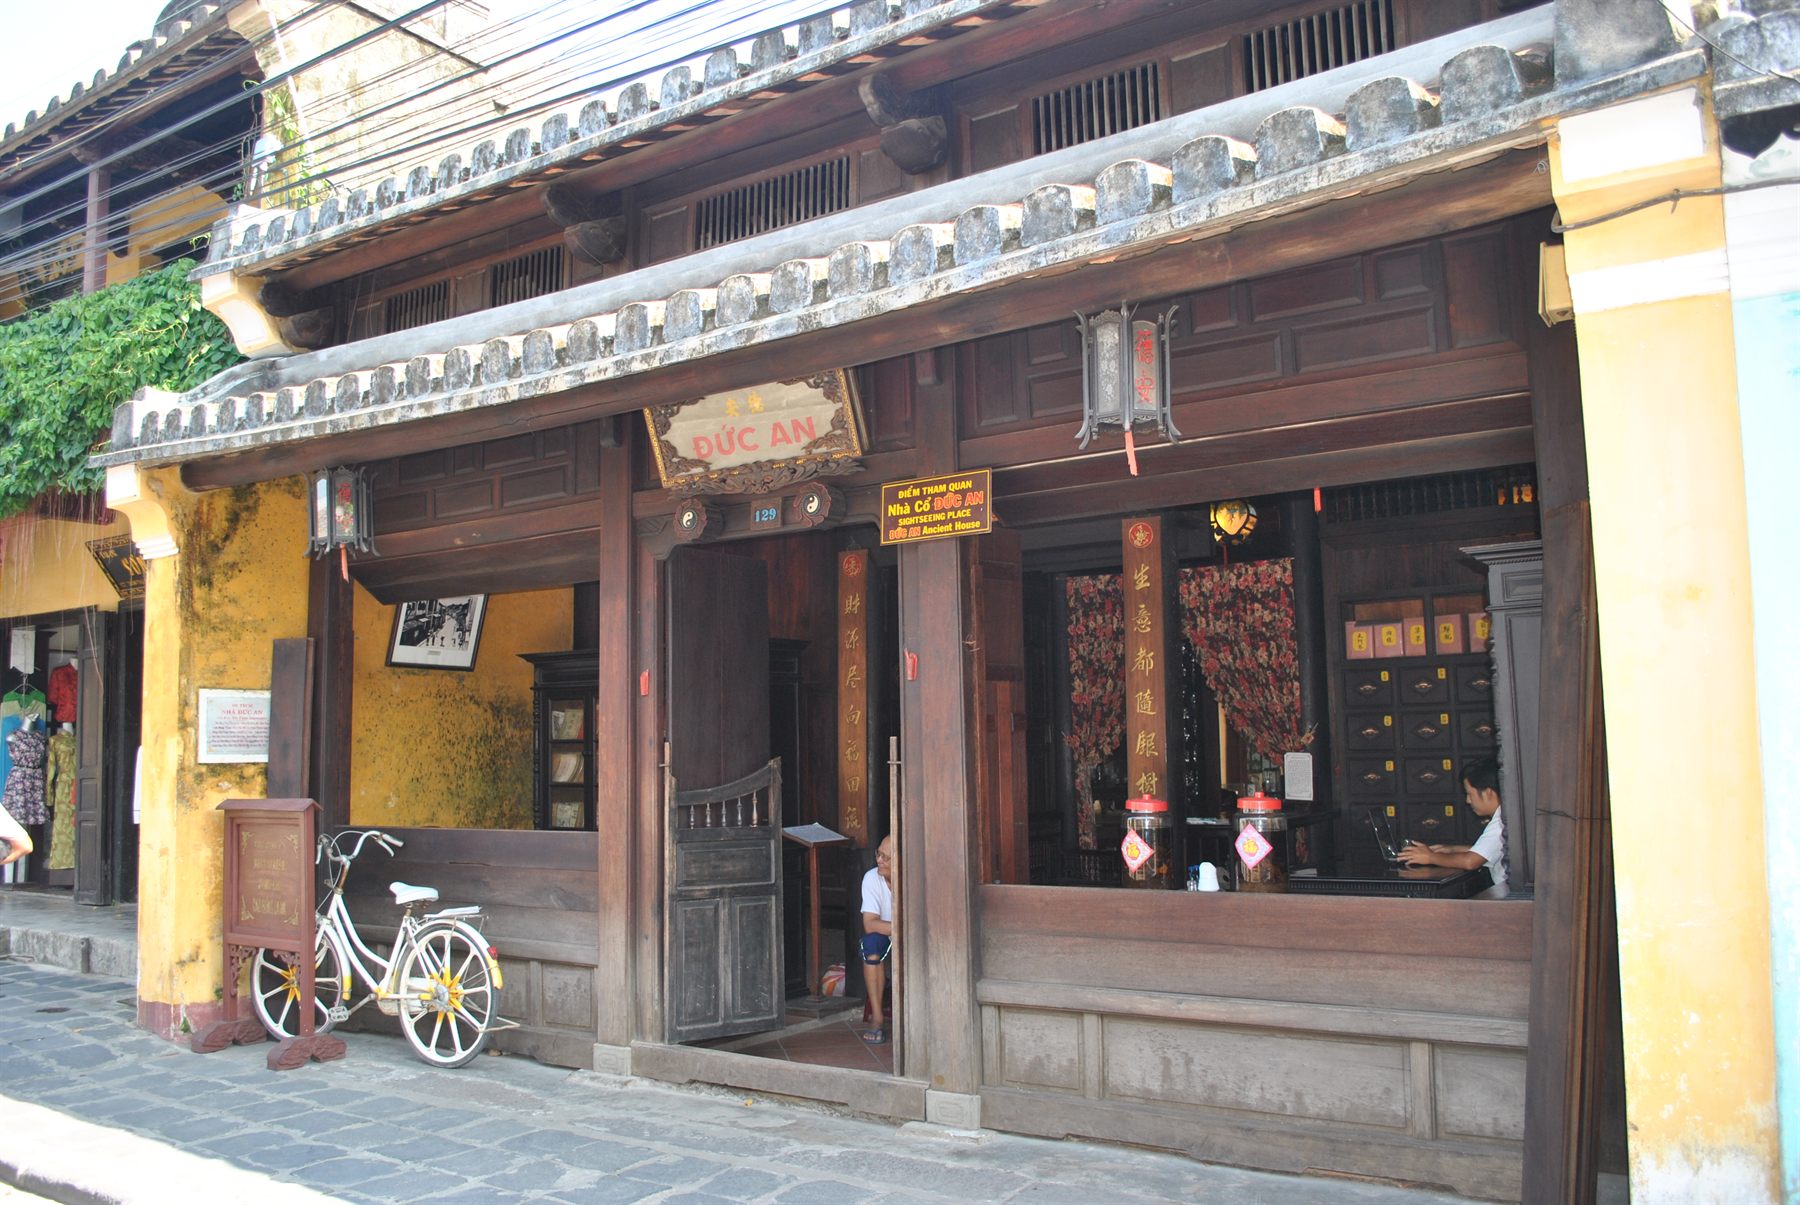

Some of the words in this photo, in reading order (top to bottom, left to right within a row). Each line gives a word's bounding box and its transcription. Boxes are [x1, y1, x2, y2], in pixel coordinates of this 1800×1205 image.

[691, 423, 760, 460] ĐỨC
[770, 416, 818, 448] AN
[898, 485, 921, 499] ĐIỂM
[922, 484, 947, 496] THAM
[948, 480, 973, 491] QUAN
[888, 503, 911, 517] Nhà
[914, 497, 932, 513] Cổ
[933, 492, 962, 511] ĐỨC
[964, 490, 984, 506] AN
[754, 507, 777, 523] 129
[898, 512, 946, 527] SIGHTSEEING
[947, 508, 971, 519] PLACE
[889, 526, 907, 540] ĐỨC
[908, 526, 921, 538] AN
[922, 522, 953, 535] Ancient
[954, 520, 981, 531] House
